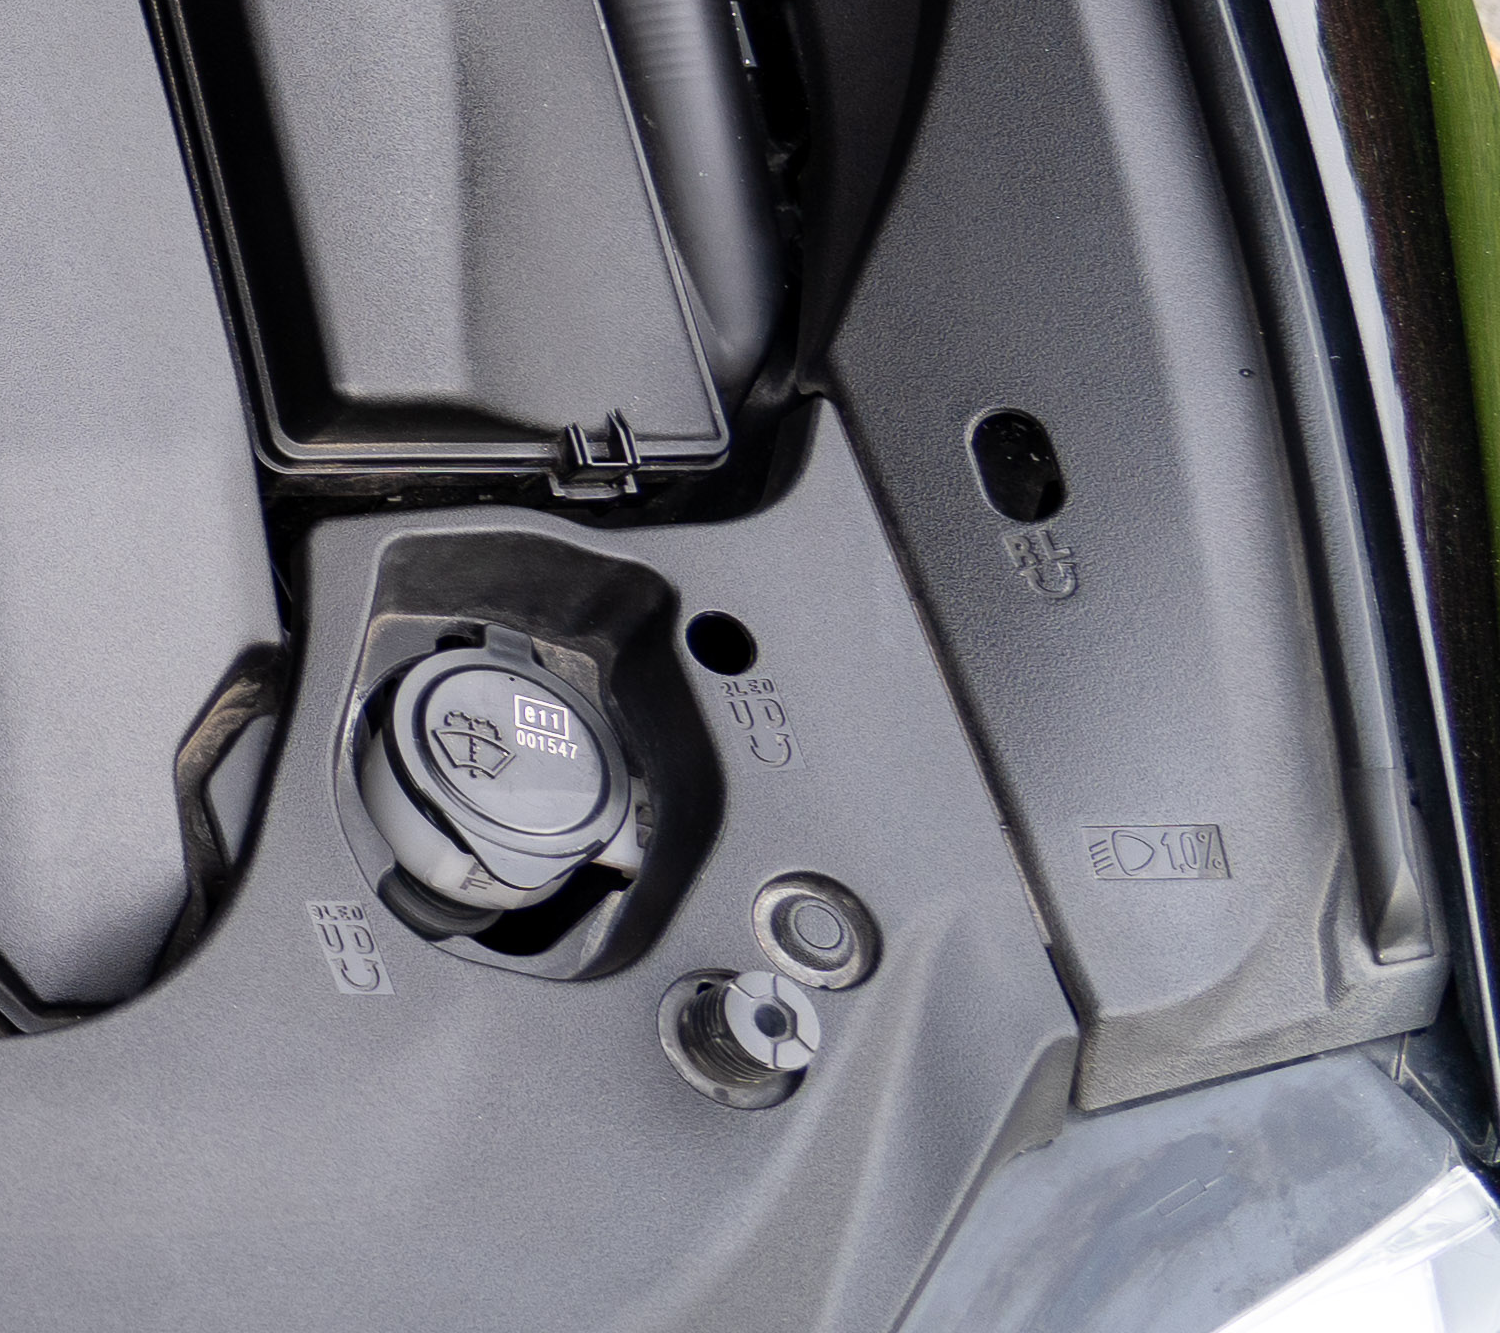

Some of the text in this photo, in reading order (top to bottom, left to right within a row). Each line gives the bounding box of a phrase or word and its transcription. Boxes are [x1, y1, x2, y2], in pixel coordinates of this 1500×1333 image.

[720, 678, 775, 698] 2LED
[523, 704, 561, 730] e11
[515, 729, 579, 760] 001547
